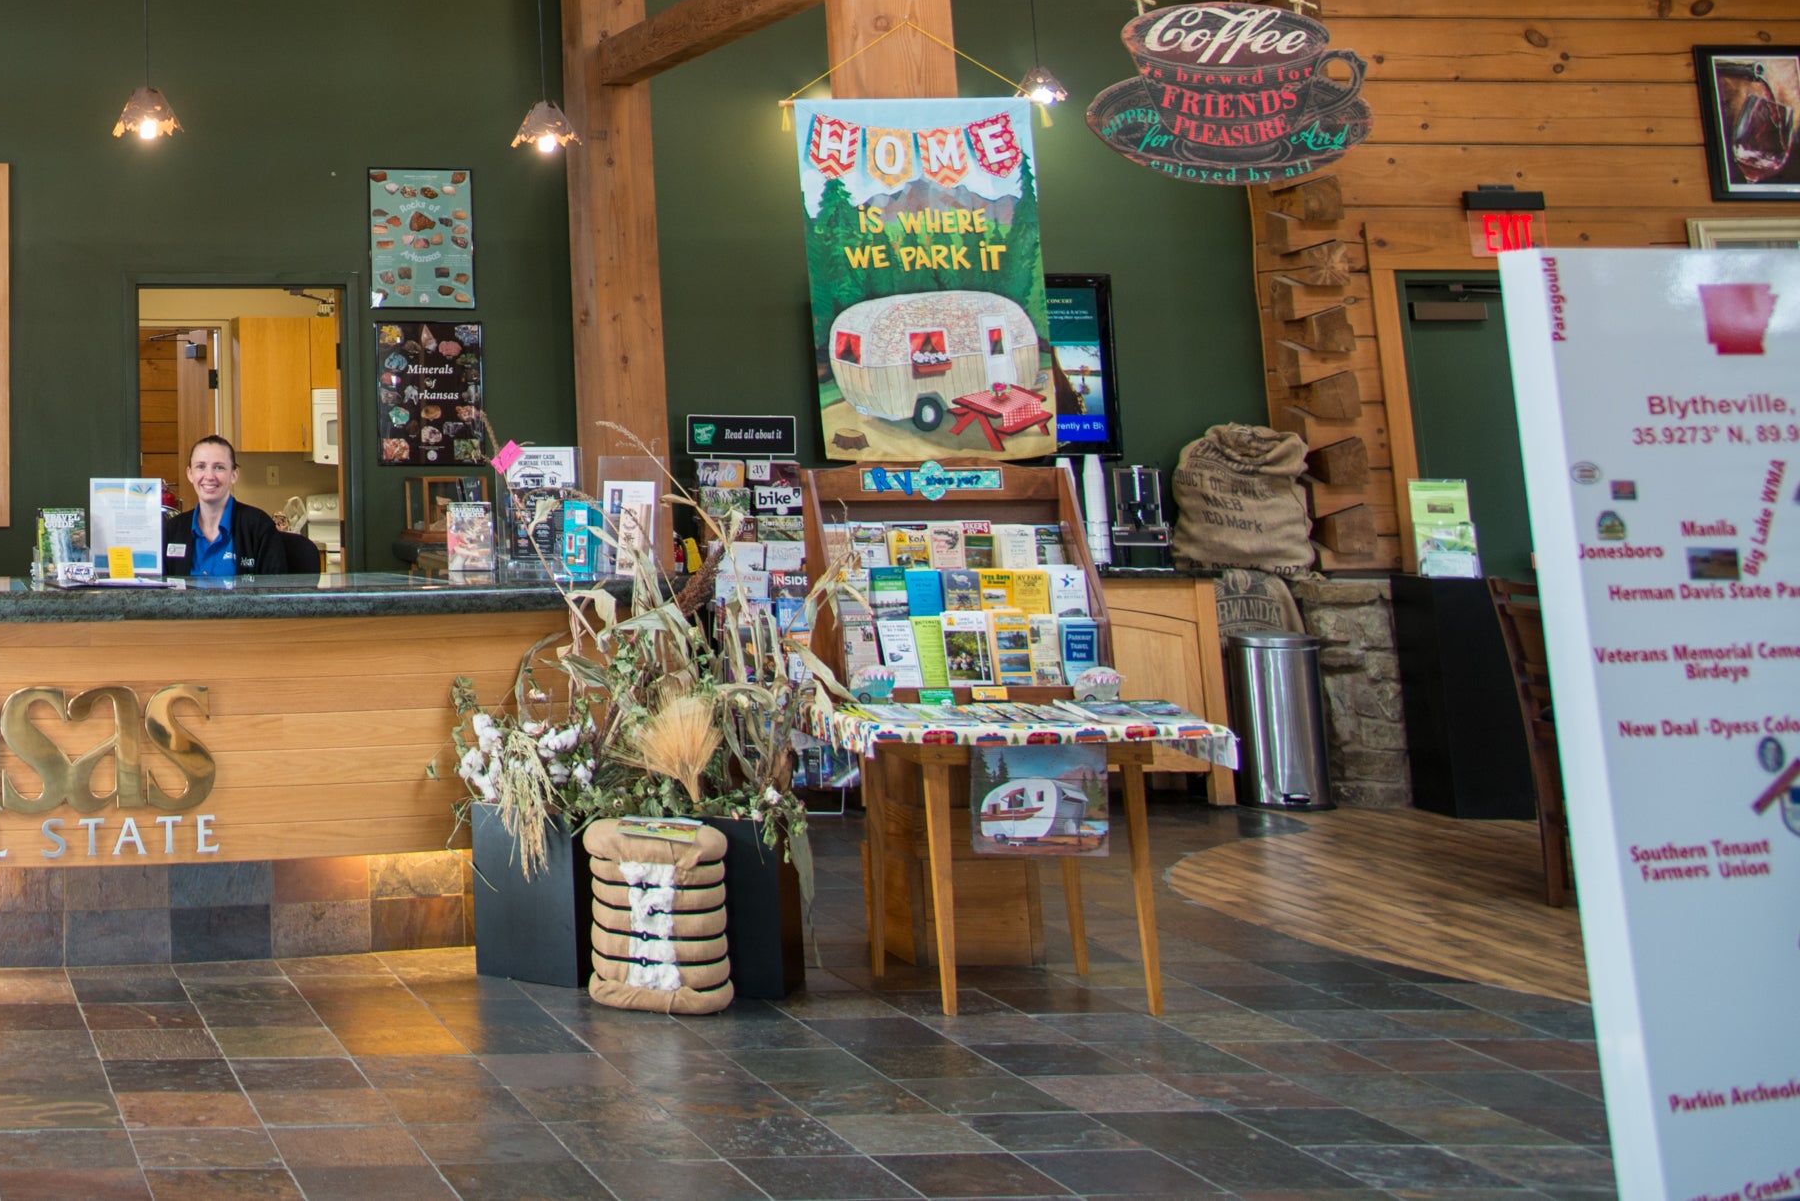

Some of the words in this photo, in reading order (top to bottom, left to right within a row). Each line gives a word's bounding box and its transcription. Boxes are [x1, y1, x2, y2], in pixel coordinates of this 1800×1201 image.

[1144, 6, 1308, 64] Coffee
[1141, 62, 1163, 79] is
[1177, 65, 1263, 85] brewed
[1277, 66, 1313, 82] for
[1160, 83, 1297, 119] FRIENDS
[1102, 108, 1160, 138] SIPPED
[1172, 113, 1292, 146] PLEASURE
[1290, 119, 1349, 150] And
[817, 123, 1011, 175] HOME
[1138, 124, 1174, 152] for
[1150, 159, 1236, 182] enjoyed
[1249, 162, 1273, 183] by
[1285, 158, 1312, 178] all
[400, 199, 426, 214] Rocks
[428, 203, 441, 214] of
[898, 208, 988, 234] WHERE
[1483, 214, 1533, 252] EXIT
[400, 250, 442, 264] Arkansas
[845, 245, 890, 269] WE
[900, 245, 972, 272] PARK
[1541, 257, 1567, 342] Paragould
[407, 364, 454, 375] Minerals
[1647, 394, 1795, 419] Blytheville,
[725, 429, 742, 439] Read
[744, 429, 753, 439] all
[755, 429, 774, 439] about
[776, 430, 782, 439] it
[1083, 422, 1090, 430] in
[752, 465, 766, 478] ay
[925, 475, 954, 486] there
[957, 475, 981, 488] yet?
[1760, 459, 1786, 503] WMA
[758, 492, 791, 505] bike
[43, 513, 80, 521] TRAVEL
[44, 520, 74, 529] GUIDE
[1225, 515, 1263, 533] Mark
[1680, 519, 1737, 537] Manila
[1749, 507, 1774, 546] Lake
[1578, 542, 1664, 560] Jonesboro
[1743, 549, 1768, 577] Big
[773, 576, 808, 585] INSIDE
[1608, 585, 1675, 601] Herman
[1679, 583, 1725, 600] Davis
[1729, 582, 1771, 599] State
[1217, 599, 1280, 624] RWANDA
[1594, 648, 1668, 664] Veterans
[1672, 643, 1753, 662] Memorial
[1685, 663, 1749, 683] Birdeye
[1619, 719, 1655, 738] New
[1660, 718, 1699, 737] Deal
[40, 814, 222, 859] STATE
[1630, 841, 1707, 864] Southern
[1711, 838, 1771, 858] Tenant
[1640, 863, 1710, 883] Farmers
[1718, 860, 1771, 879] Union
[1668, 1088, 1726, 1113] Parkin
